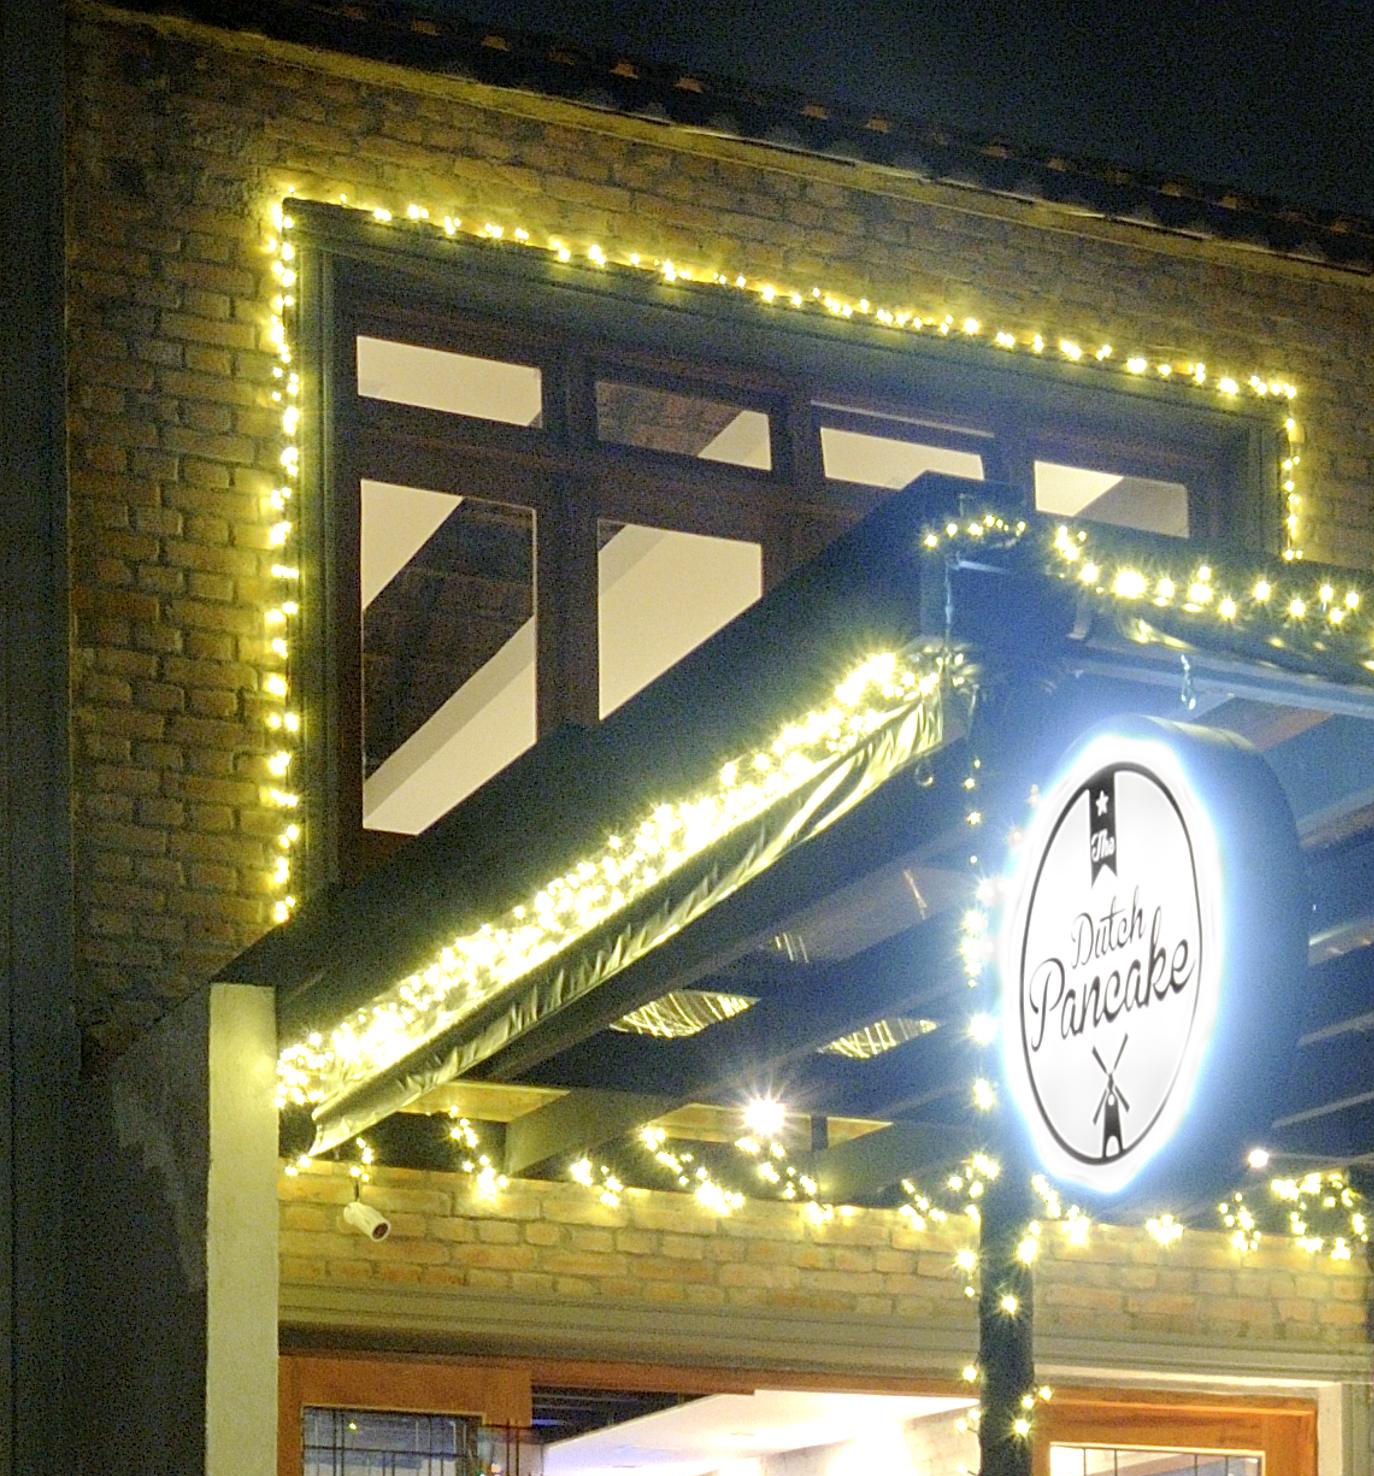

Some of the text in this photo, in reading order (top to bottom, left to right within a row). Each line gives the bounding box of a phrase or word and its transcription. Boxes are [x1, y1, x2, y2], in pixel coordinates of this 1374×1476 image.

[1091, 828, 1115, 863] The
[1071, 885, 1146, 970] Dutch
[1029, 905, 1196, 1053] Pancake
